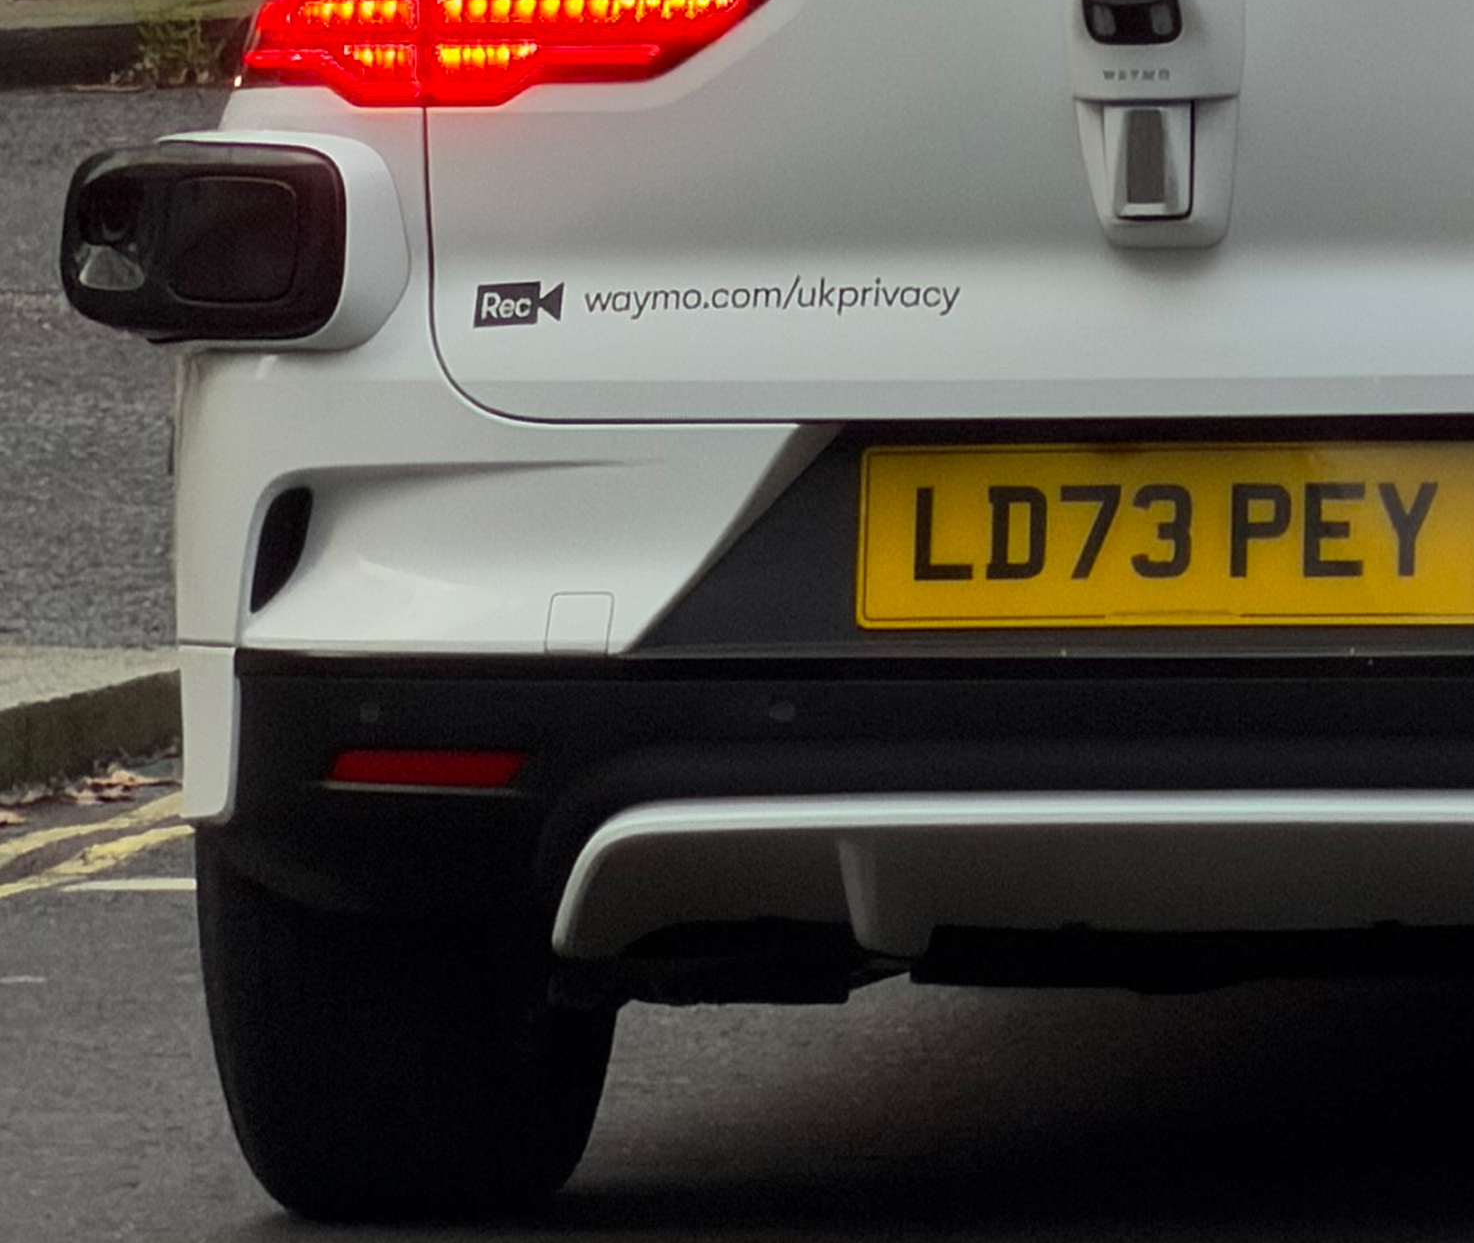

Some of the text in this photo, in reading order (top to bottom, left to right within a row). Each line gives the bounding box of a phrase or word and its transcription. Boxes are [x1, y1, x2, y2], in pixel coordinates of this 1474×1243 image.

[480, 274, 961, 321] Rec waymo.com/ukprivacy
[913, 481, 1440, 582] LD73 PEY
